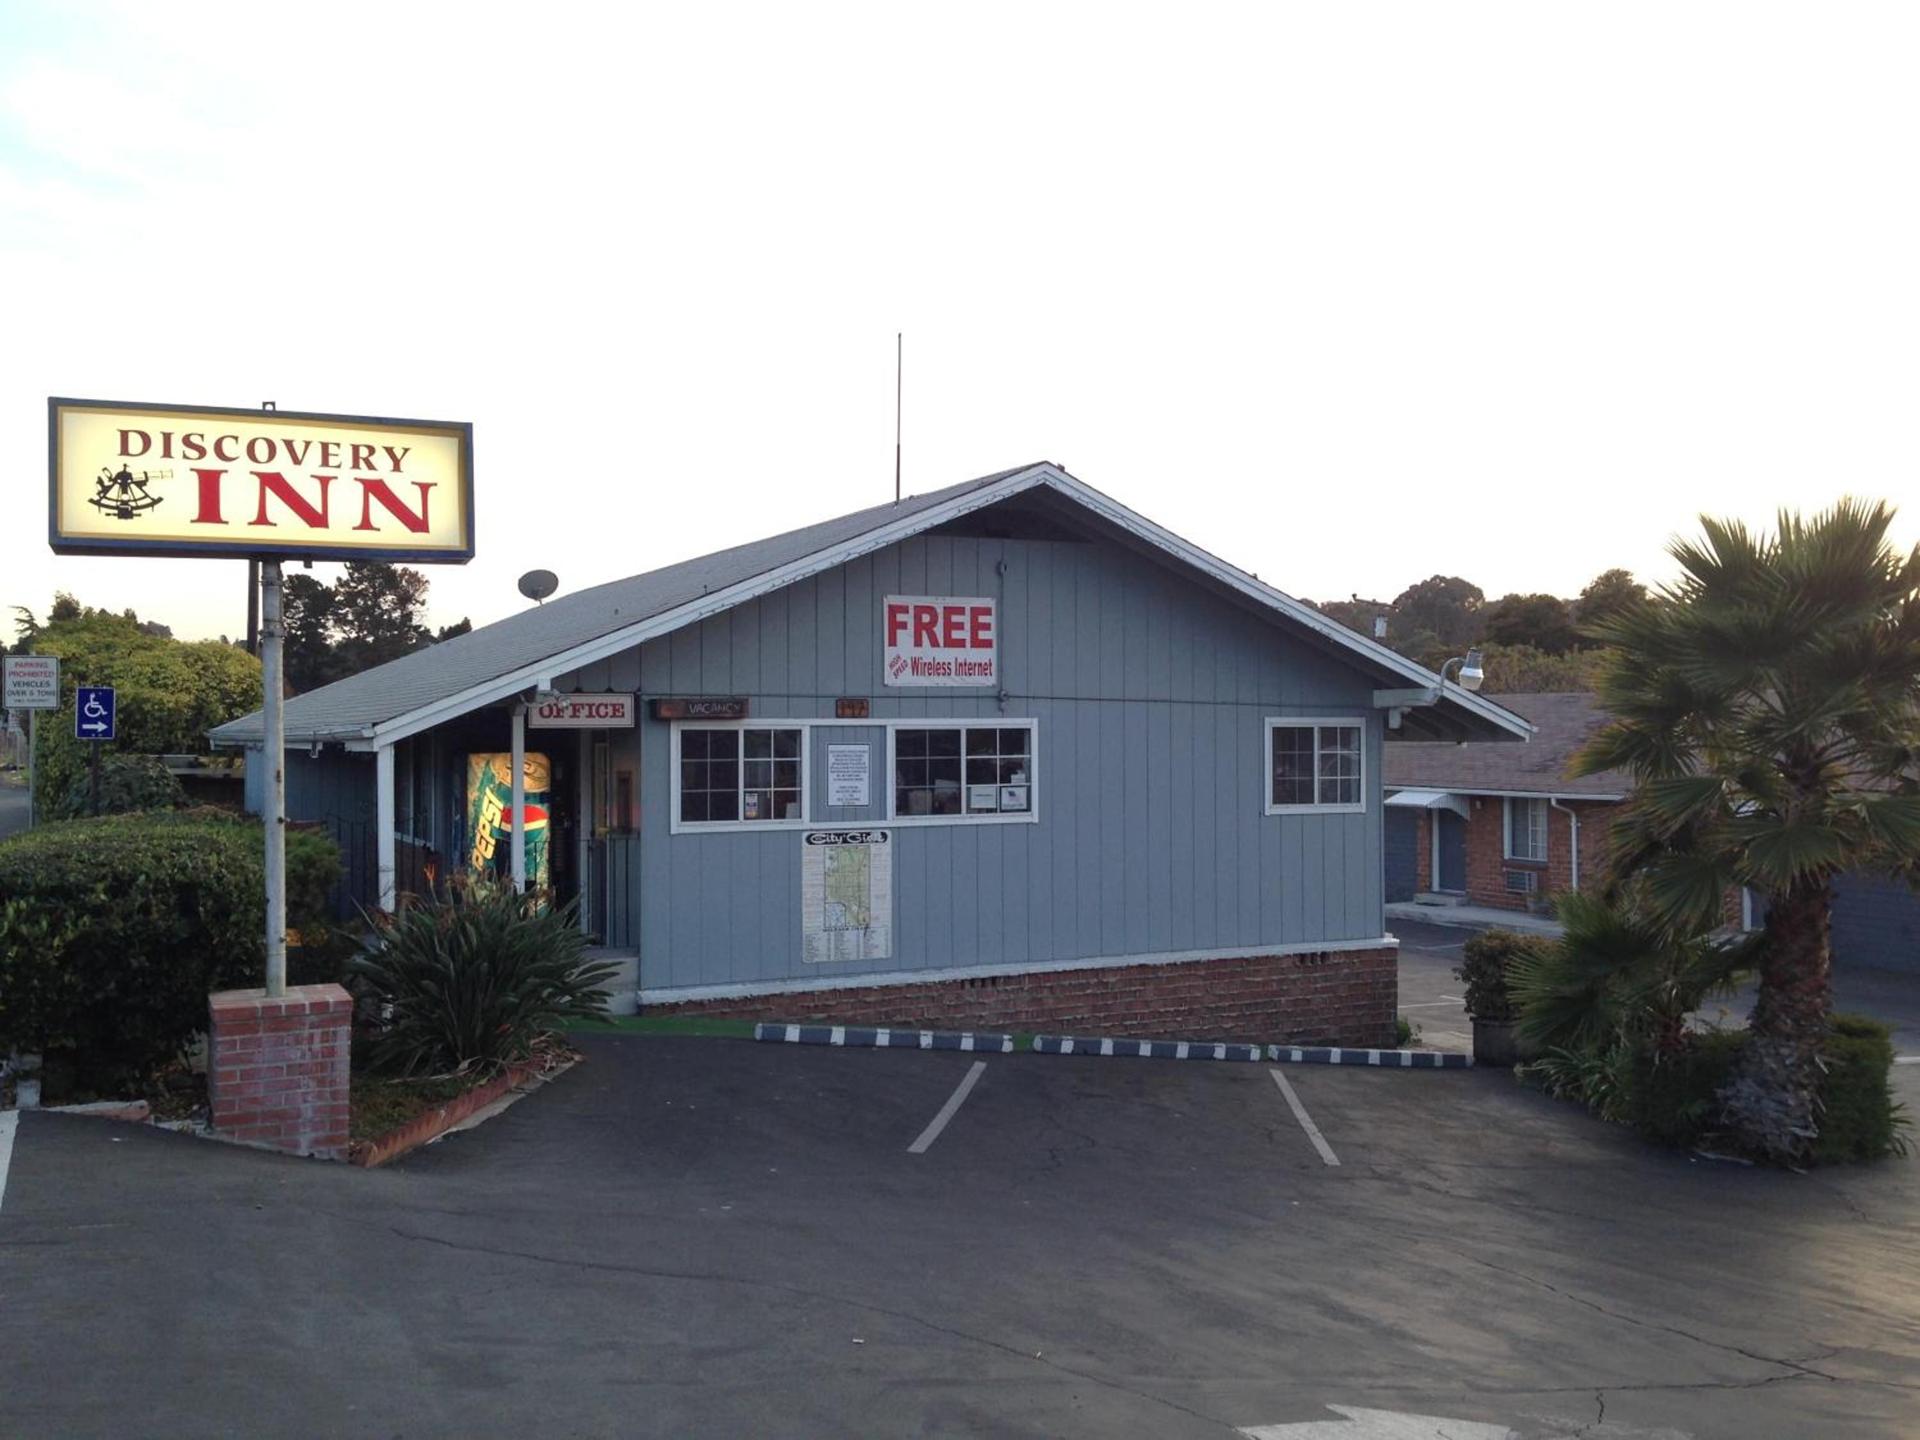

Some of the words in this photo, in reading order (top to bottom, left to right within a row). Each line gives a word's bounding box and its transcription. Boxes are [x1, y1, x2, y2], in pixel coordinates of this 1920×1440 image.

[118, 429, 412, 473] DISCOVERY
[190, 468, 437, 533] INN
[888, 604, 993, 648] FREE
[910, 656, 952, 676] Wireless
[954, 657, 992, 676] Internet
[538, 702, 625, 719] OFFICE
[689, 703, 741, 715] VACANCY
[471, 786, 505, 872] PEPSI
[810, 832, 844, 846] City
